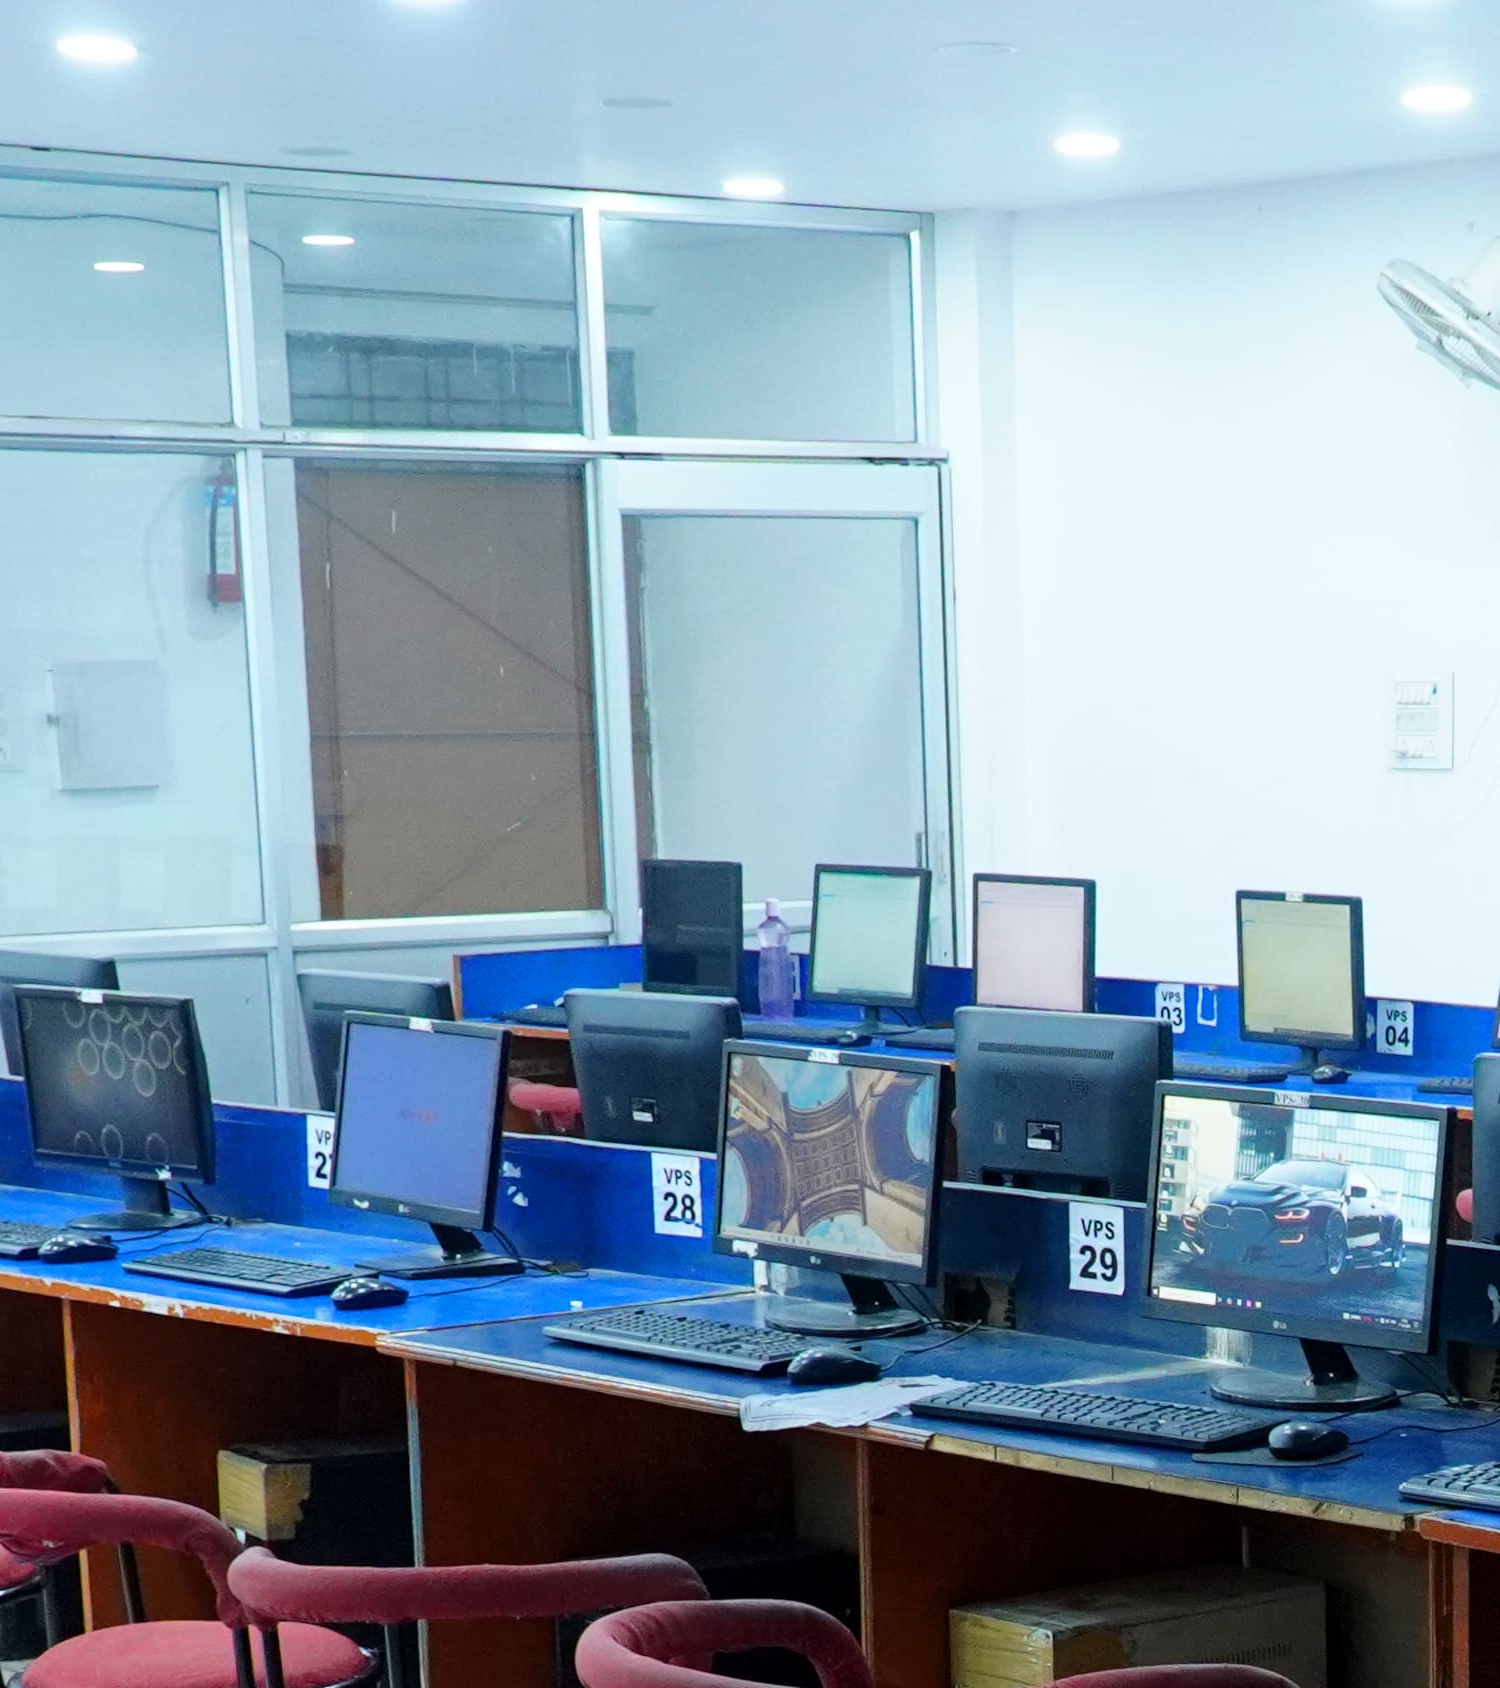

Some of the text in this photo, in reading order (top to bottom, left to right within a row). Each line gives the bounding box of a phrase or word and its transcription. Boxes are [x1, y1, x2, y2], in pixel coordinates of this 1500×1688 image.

[1160, 990, 1182, 1004] VPS
[1385, 1008, 1408, 1023] VPS
[1384, 1026, 1410, 1048] 04
[314, 1127, 332, 1146] VP
[663, 1166, 694, 1188] VPS
[663, 1190, 698, 1226] 28
[1080, 1218, 1116, 1241] VPS
[1079, 1244, 1119, 1283] 29
